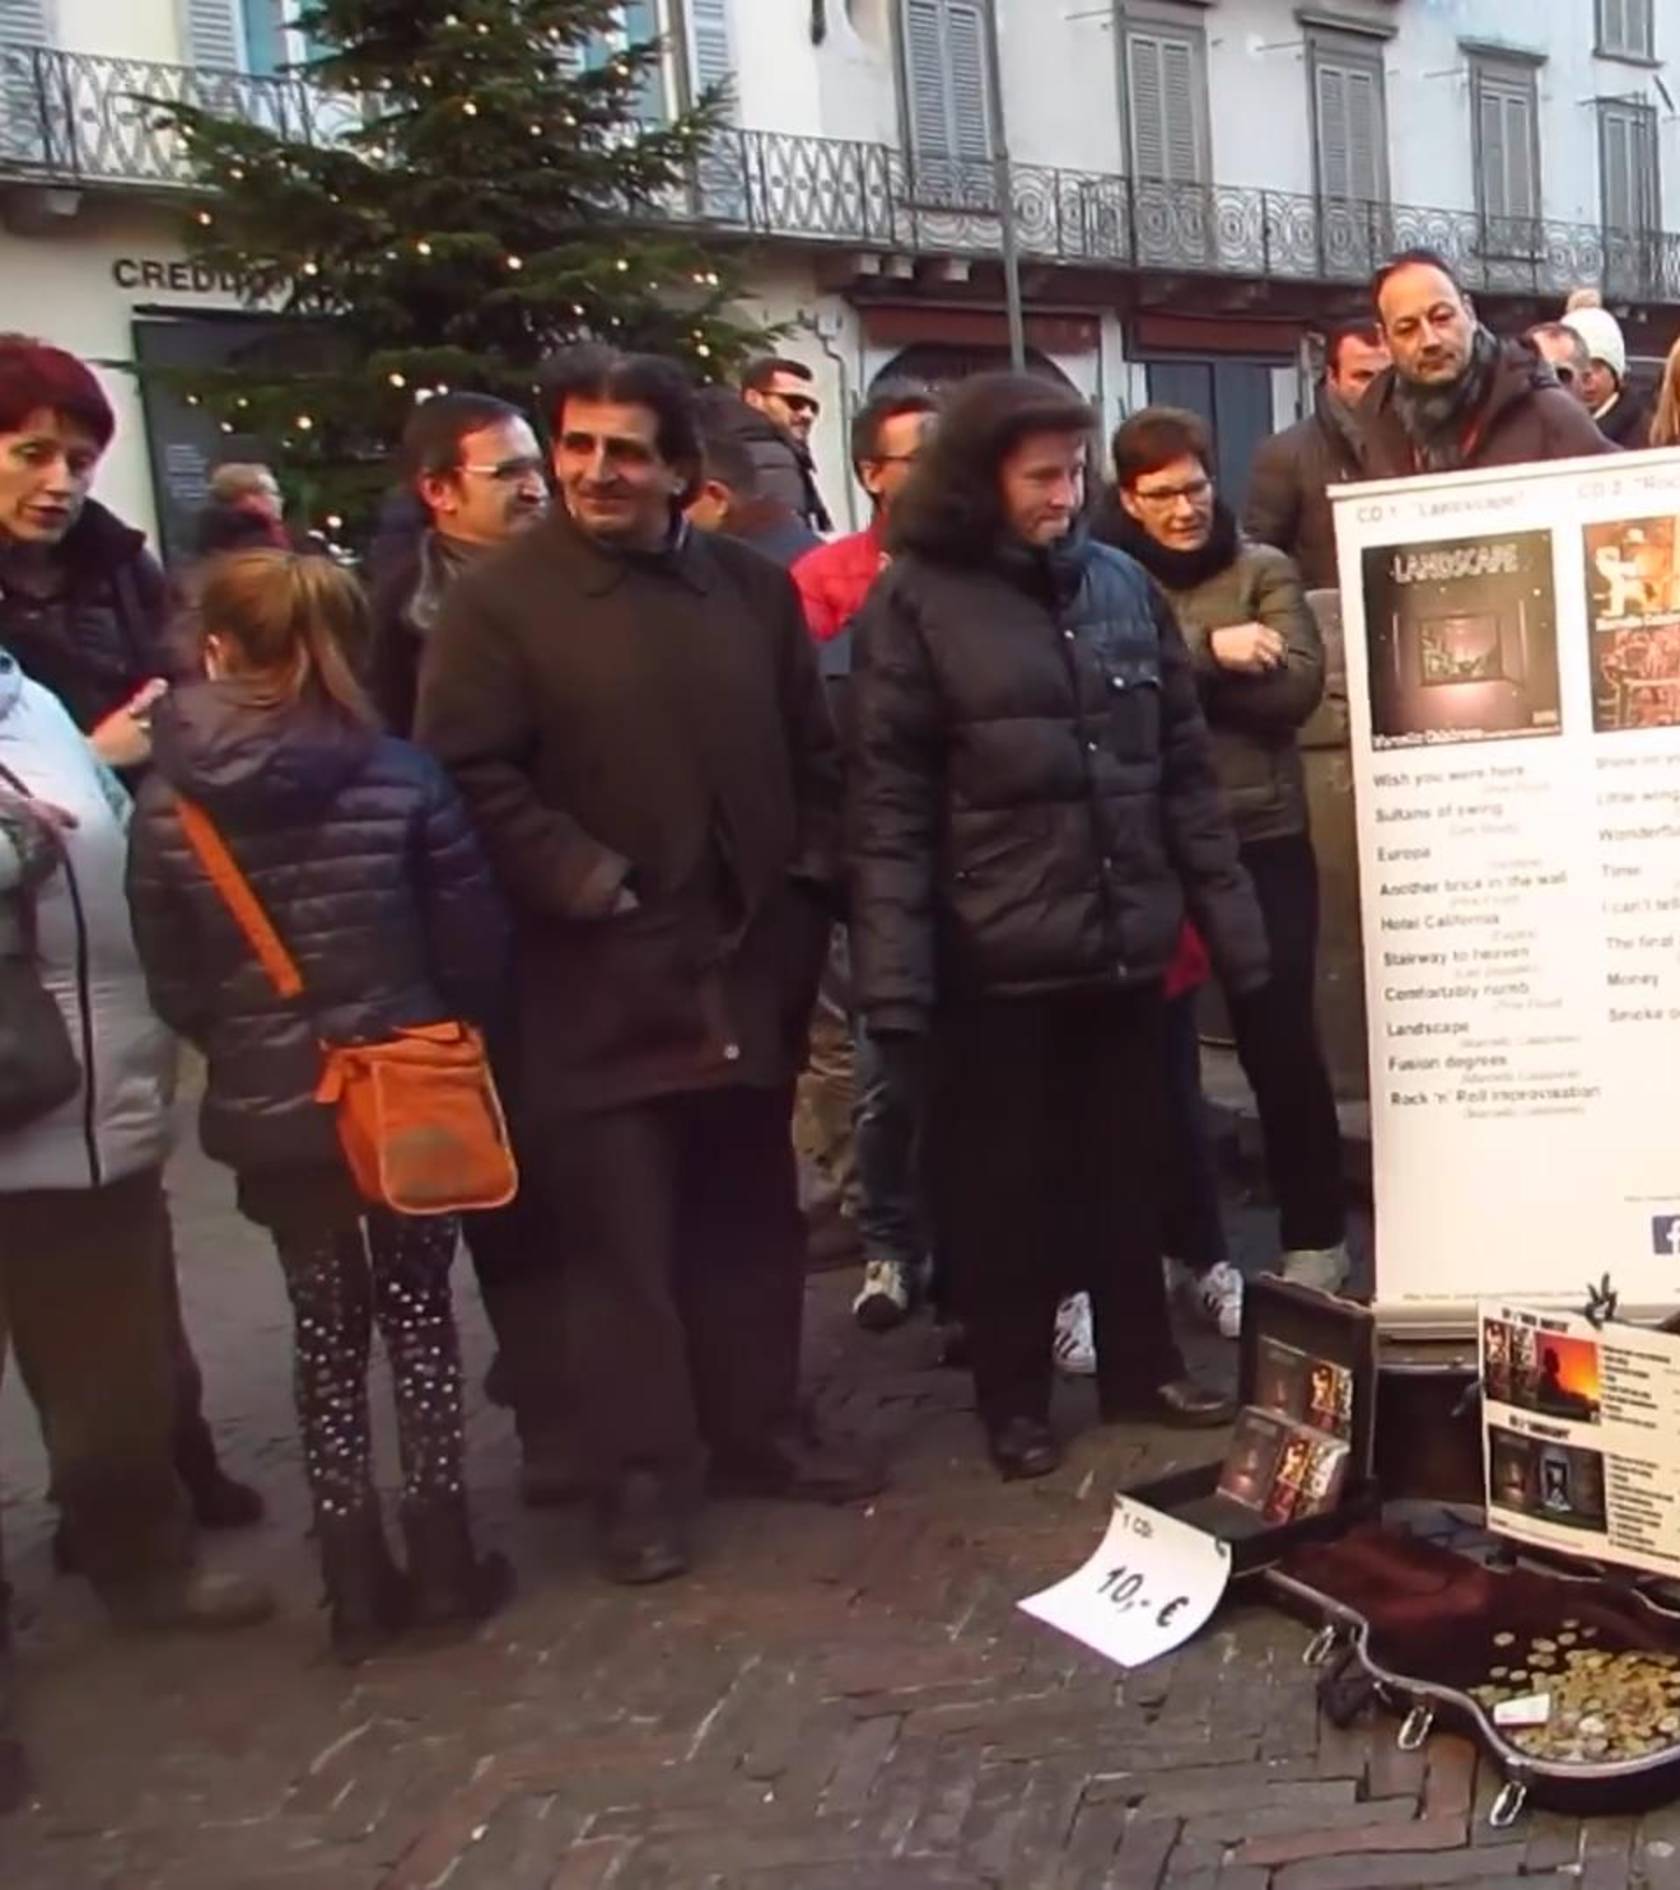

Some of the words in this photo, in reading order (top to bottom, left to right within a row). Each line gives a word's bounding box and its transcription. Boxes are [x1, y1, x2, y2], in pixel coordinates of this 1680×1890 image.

[113, 258, 248, 293] CREDI
[1394, 543, 1519, 584] LANDSCAPE
[1373, 772, 1410, 788] Wish
[1415, 773, 1443, 788] you
[1449, 768, 1485, 781] were
[1490, 765, 1524, 777] here
[1375, 807, 1431, 823] Sultans
[1437, 803, 1452, 818] of
[1458, 803, 1503, 818] swing
[1376, 845, 1431, 863] Europa
[1379, 881, 1439, 897] Another
[1444, 878, 1482, 892] brick
[1487, 878, 1502, 889] in
[1508, 875, 1532, 887] the
[1537, 870, 1567, 885] wall
[1380, 915, 1419, 931] Hotel
[1424, 913, 1499, 930] California
[1606, 936, 1634, 950] The
[1384, 951, 1447, 967] Stairway
[1473, 946, 1529, 961] heaven
[1606, 971, 1658, 990] Money
[1385, 984, 1479, 1002] Comfortably
[1484, 982, 1530, 996] numb
[1609, 1006, 1664, 1023] Smoke
[1386, 1022, 1470, 1037] Landscape
[1388, 1055, 1440, 1071] Fusion
[1444, 1055, 1509, 1073] degrees
[1389, 1091, 1428, 1106] Rock
[1456, 1089, 1488, 1103] Roll
[1155, 1595, 1190, 1628] €
